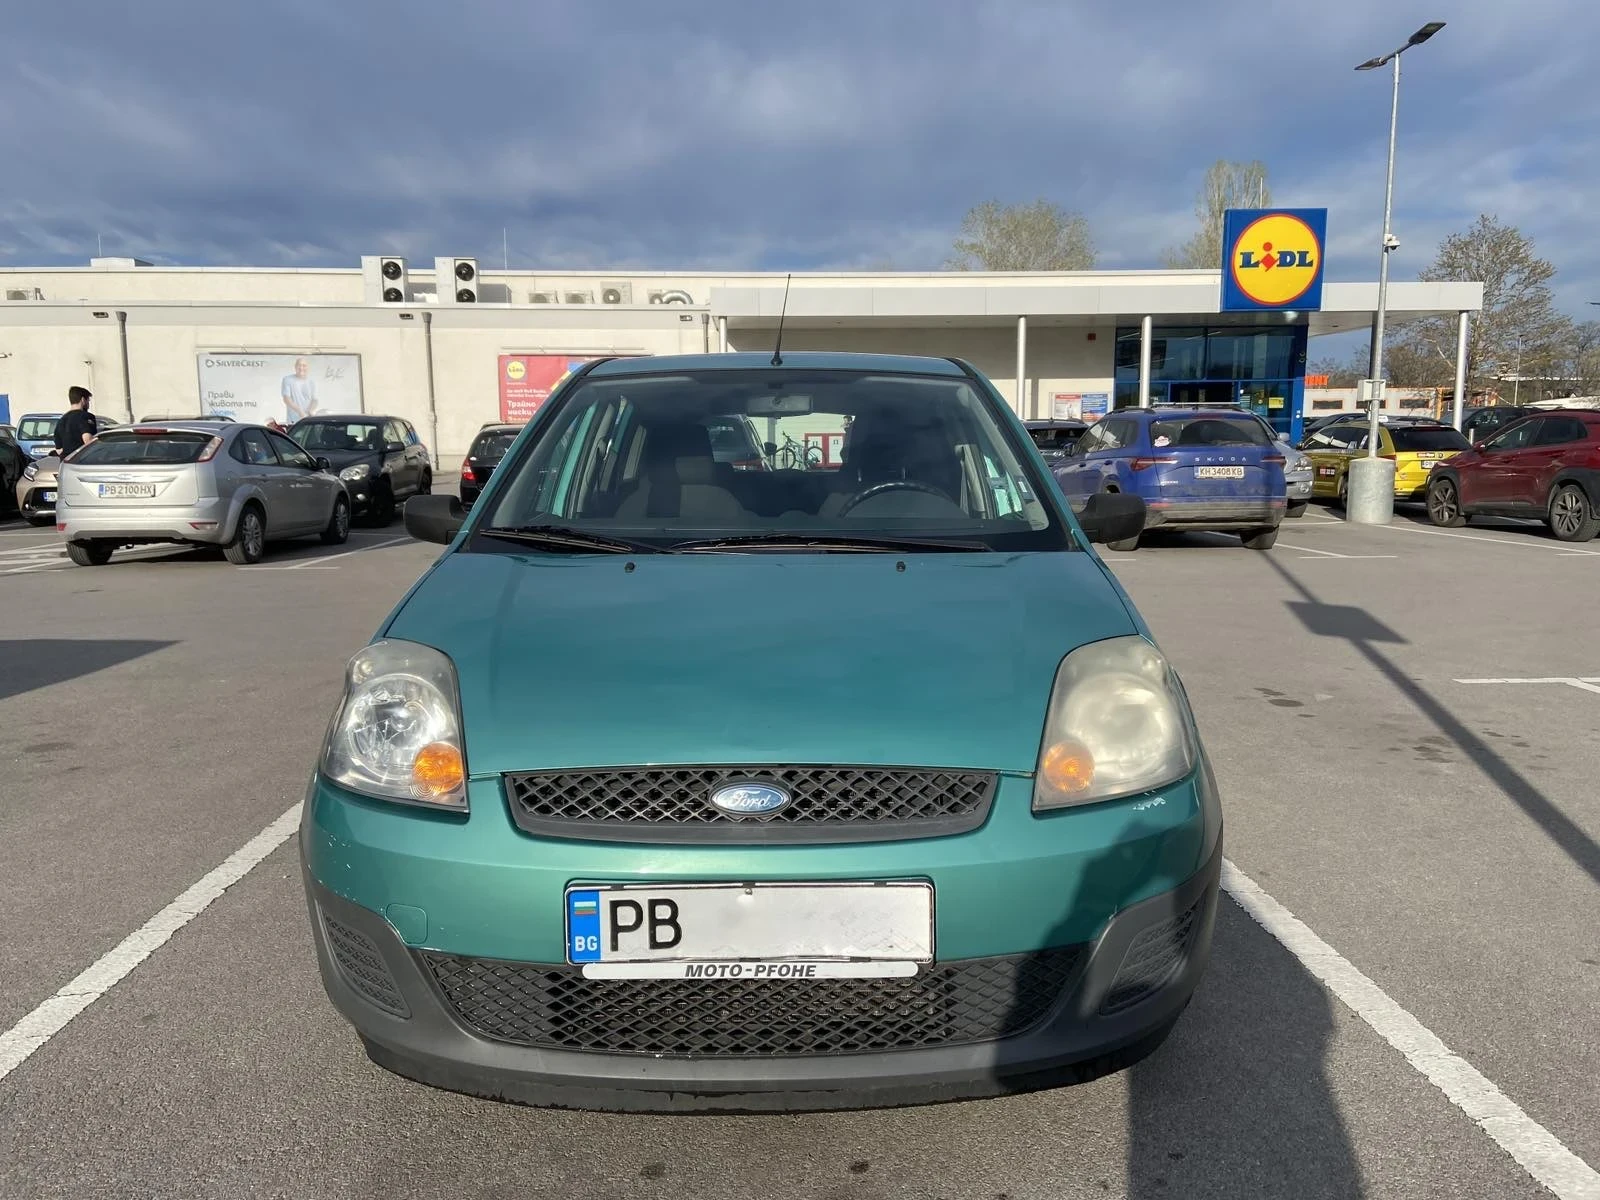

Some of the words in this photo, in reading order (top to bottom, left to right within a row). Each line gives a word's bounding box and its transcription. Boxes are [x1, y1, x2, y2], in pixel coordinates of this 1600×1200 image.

[1239, 242, 1313, 272] LIDL
[208, 390, 234, 399] Прави
[728, 789, 771, 807] Ford
[609, 898, 682, 952] PB
[575, 936, 598, 952] BG
